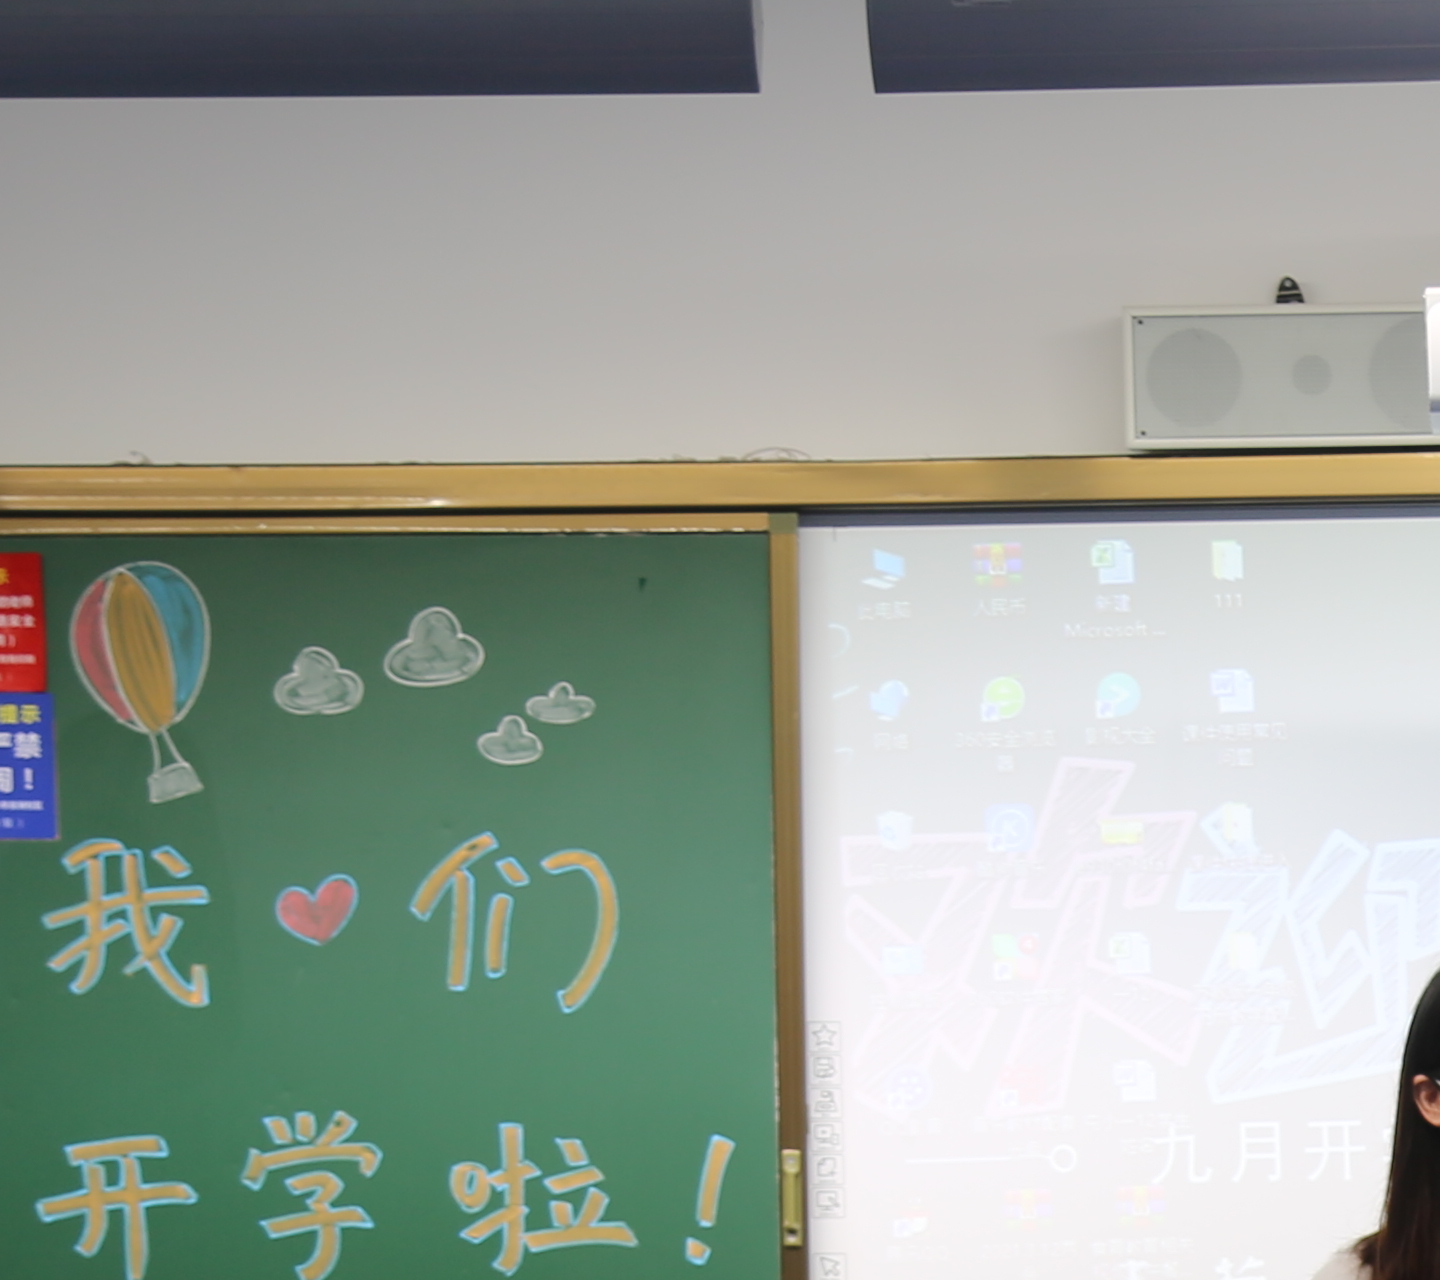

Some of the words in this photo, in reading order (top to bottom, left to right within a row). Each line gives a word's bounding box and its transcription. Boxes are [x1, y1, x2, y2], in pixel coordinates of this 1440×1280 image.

[1063, 620, 1148, 638] Microsoft
[1152, 1117, 1392, 1185] 九月开
